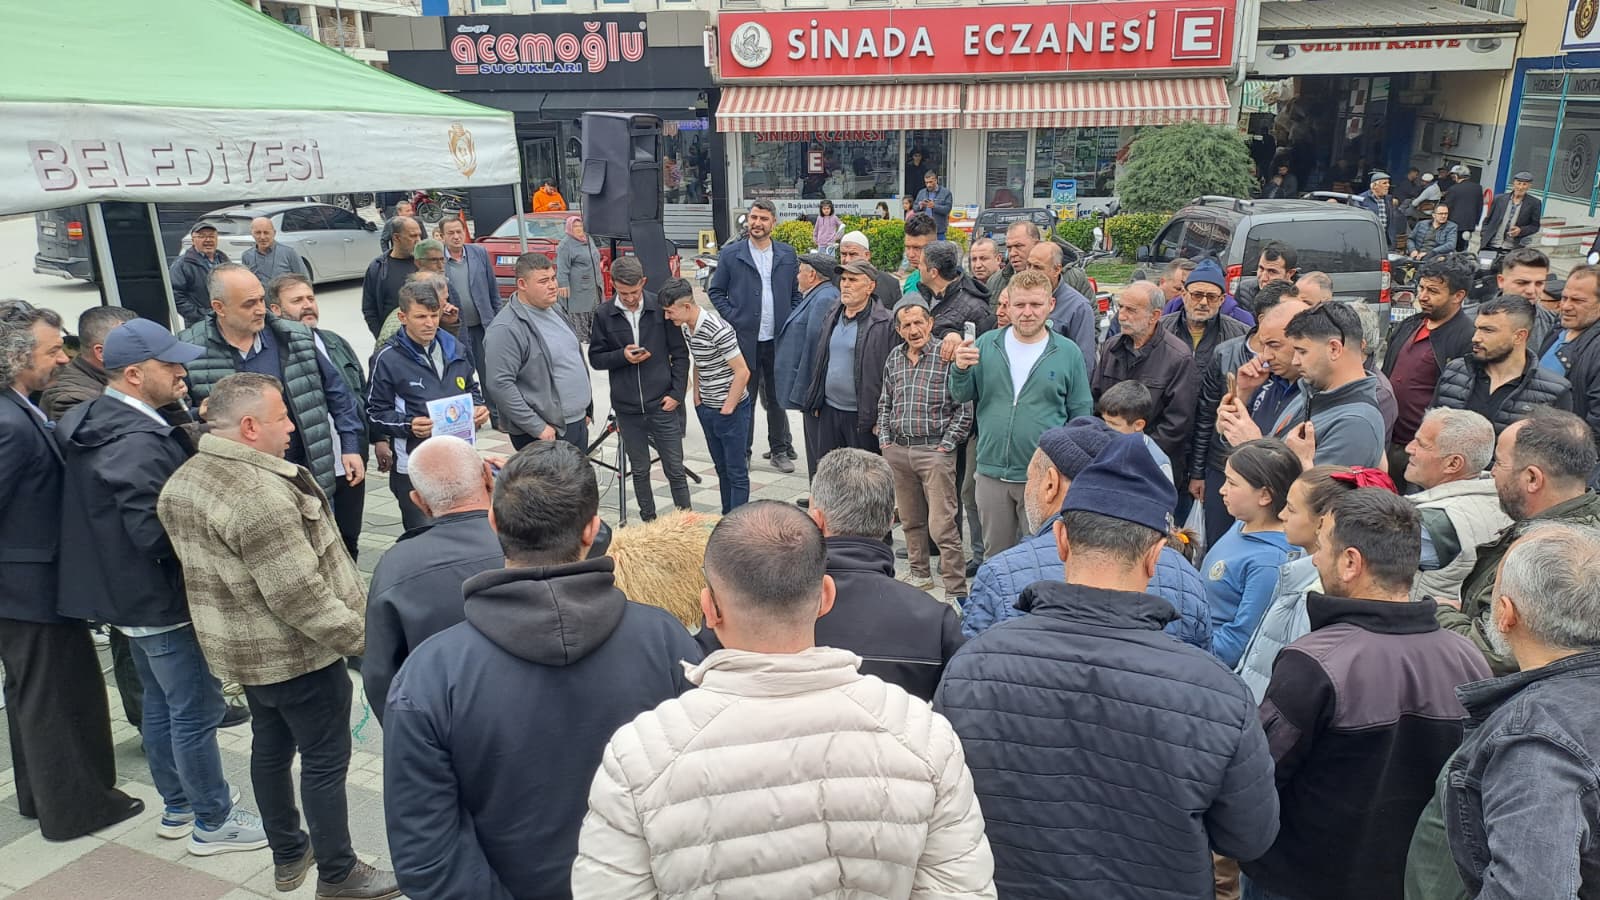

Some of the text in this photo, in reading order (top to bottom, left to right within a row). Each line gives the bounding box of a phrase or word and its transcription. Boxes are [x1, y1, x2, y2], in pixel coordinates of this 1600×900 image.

[451, 22, 644, 73] acemoğlu
[788, 9, 1157, 60] SİNADA ECZANESİ
[1182, 16, 1215, 51] E
[480, 63, 583, 75] SUCUKLARI
[28, 140, 325, 192] BELEDİYESİ
